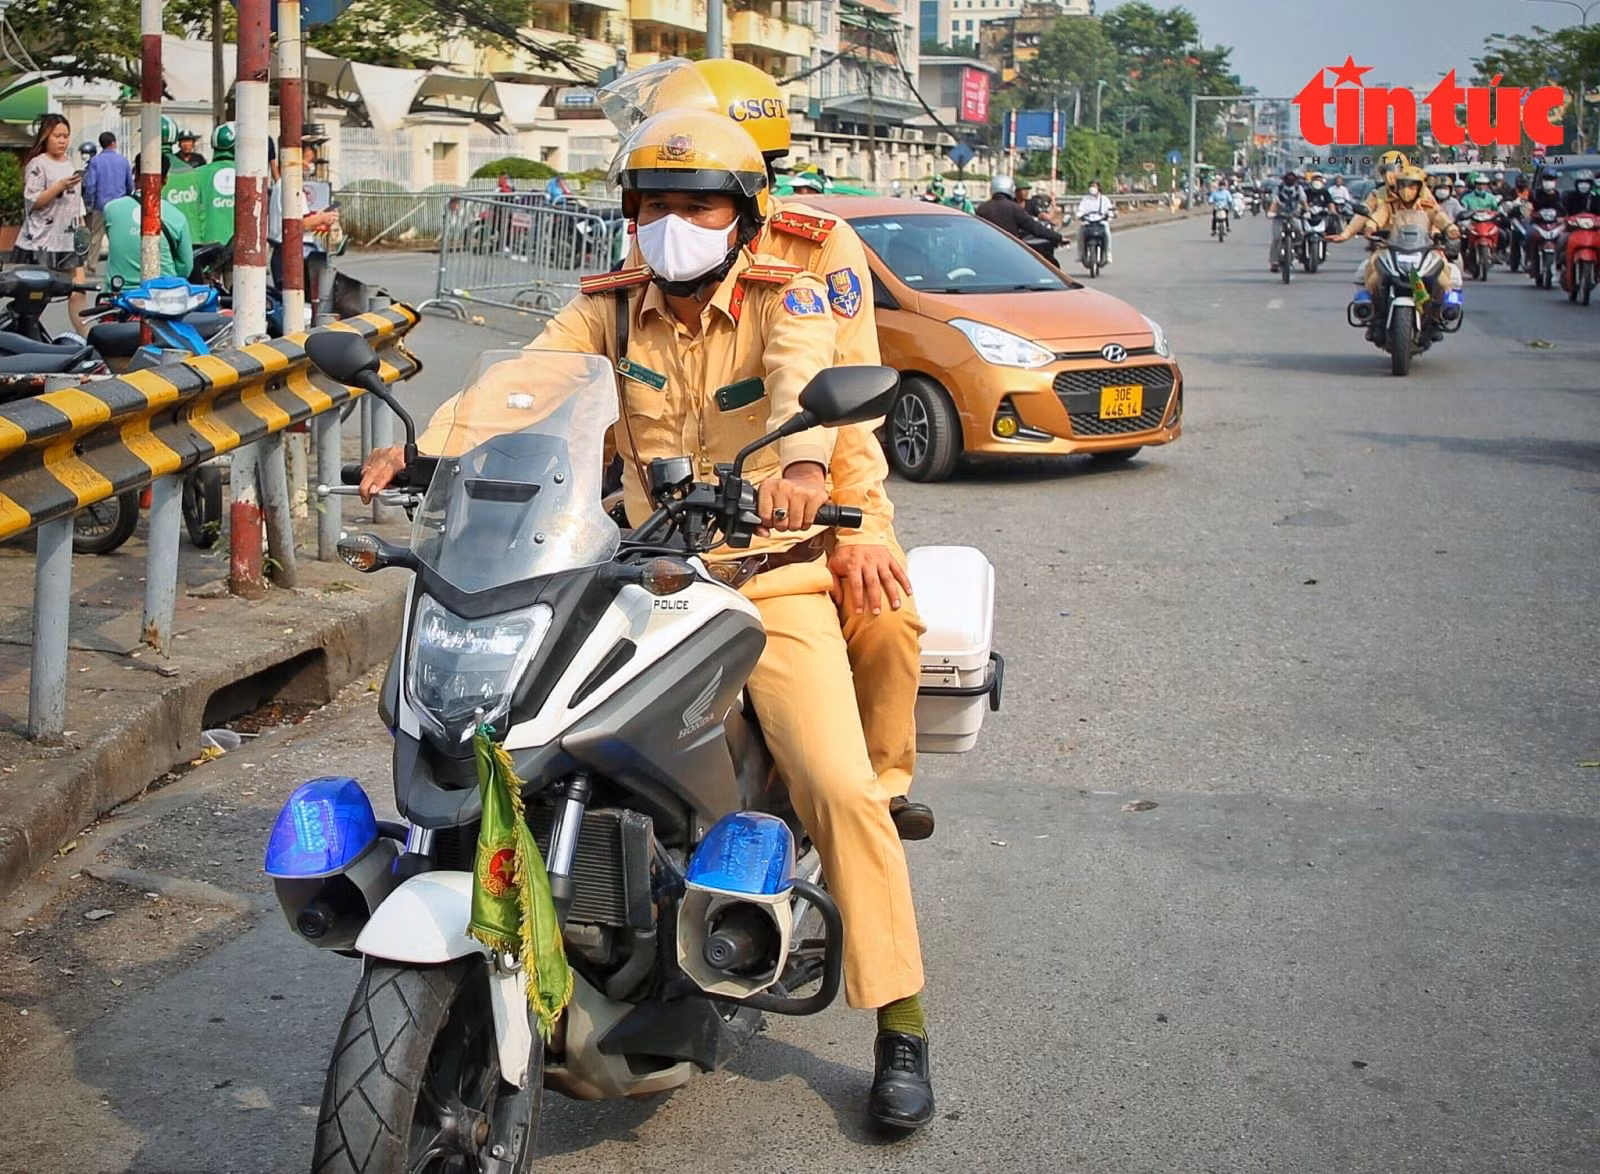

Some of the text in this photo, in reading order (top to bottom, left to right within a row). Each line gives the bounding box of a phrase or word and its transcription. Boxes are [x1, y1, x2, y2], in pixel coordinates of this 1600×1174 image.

[728, 98, 785, 122] CSGT
[1114, 388, 1132, 401] 30E
[1104, 402, 1138, 416] 446.14
[653, 600, 689, 610] POLICE
[677, 712, 715, 740] HONDA
